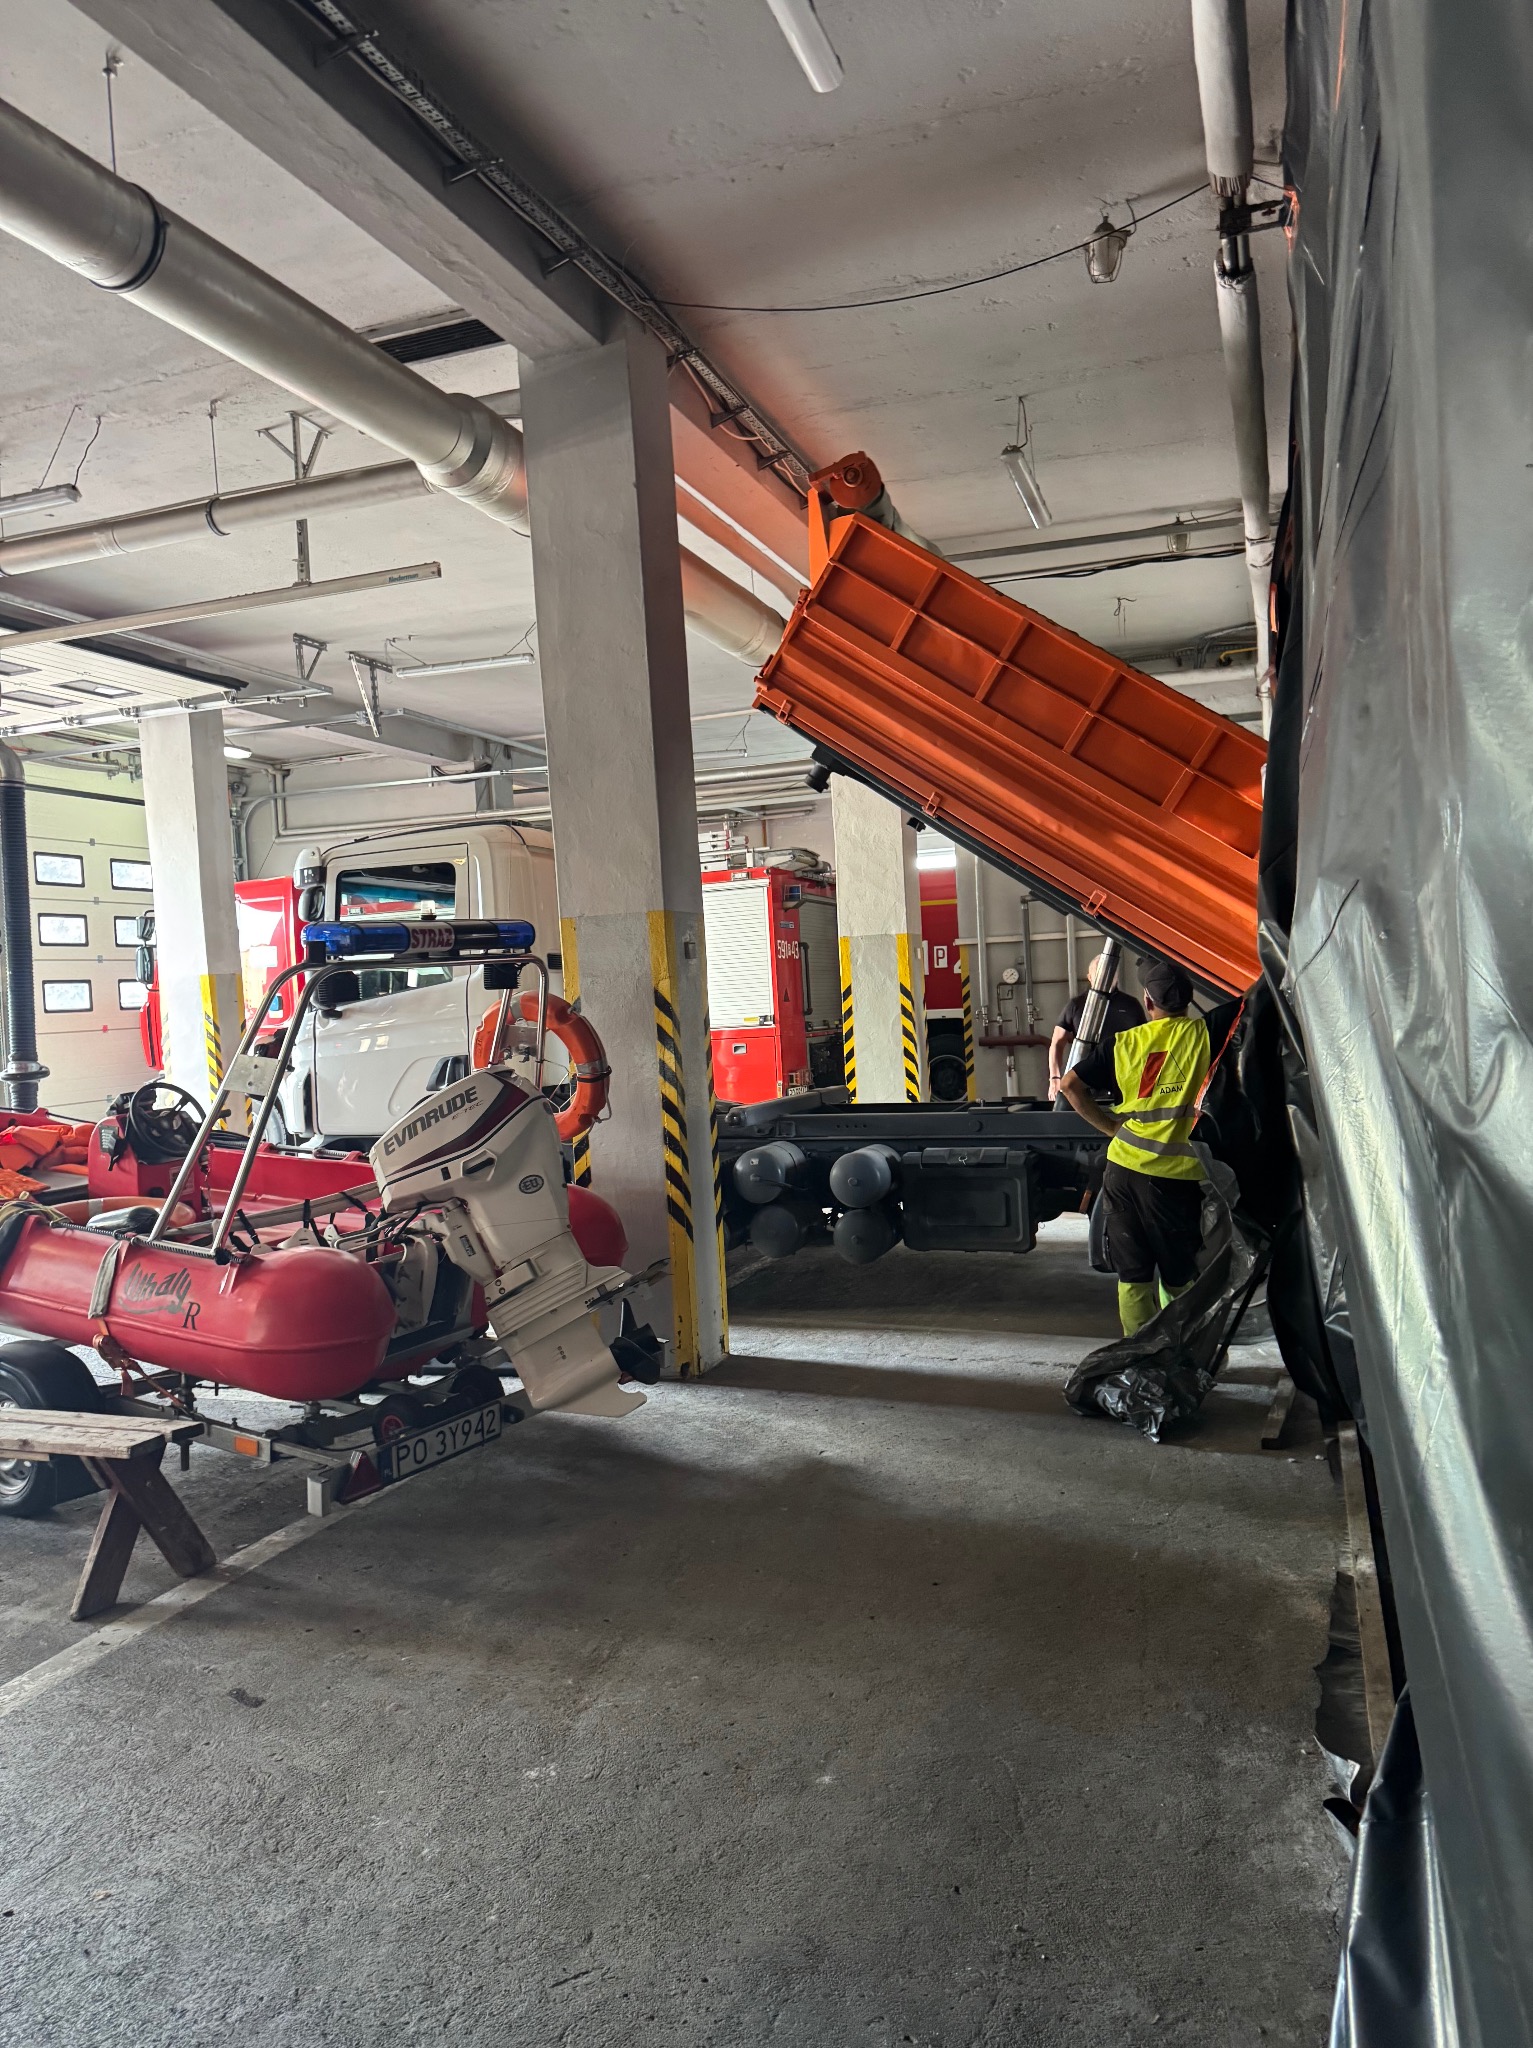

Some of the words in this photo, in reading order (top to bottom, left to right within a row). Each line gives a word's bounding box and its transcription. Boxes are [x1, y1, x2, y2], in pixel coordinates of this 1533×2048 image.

[1160, 1084, 1184, 1095] ADAM
[383, 1085, 478, 1157] EVINRUDE
[124, 1262, 192, 1309] Whaly
[181, 1301, 201, 1331] R
[396, 1437, 428, 1479] PO
[436, 1408, 497, 1457] 3Y942
